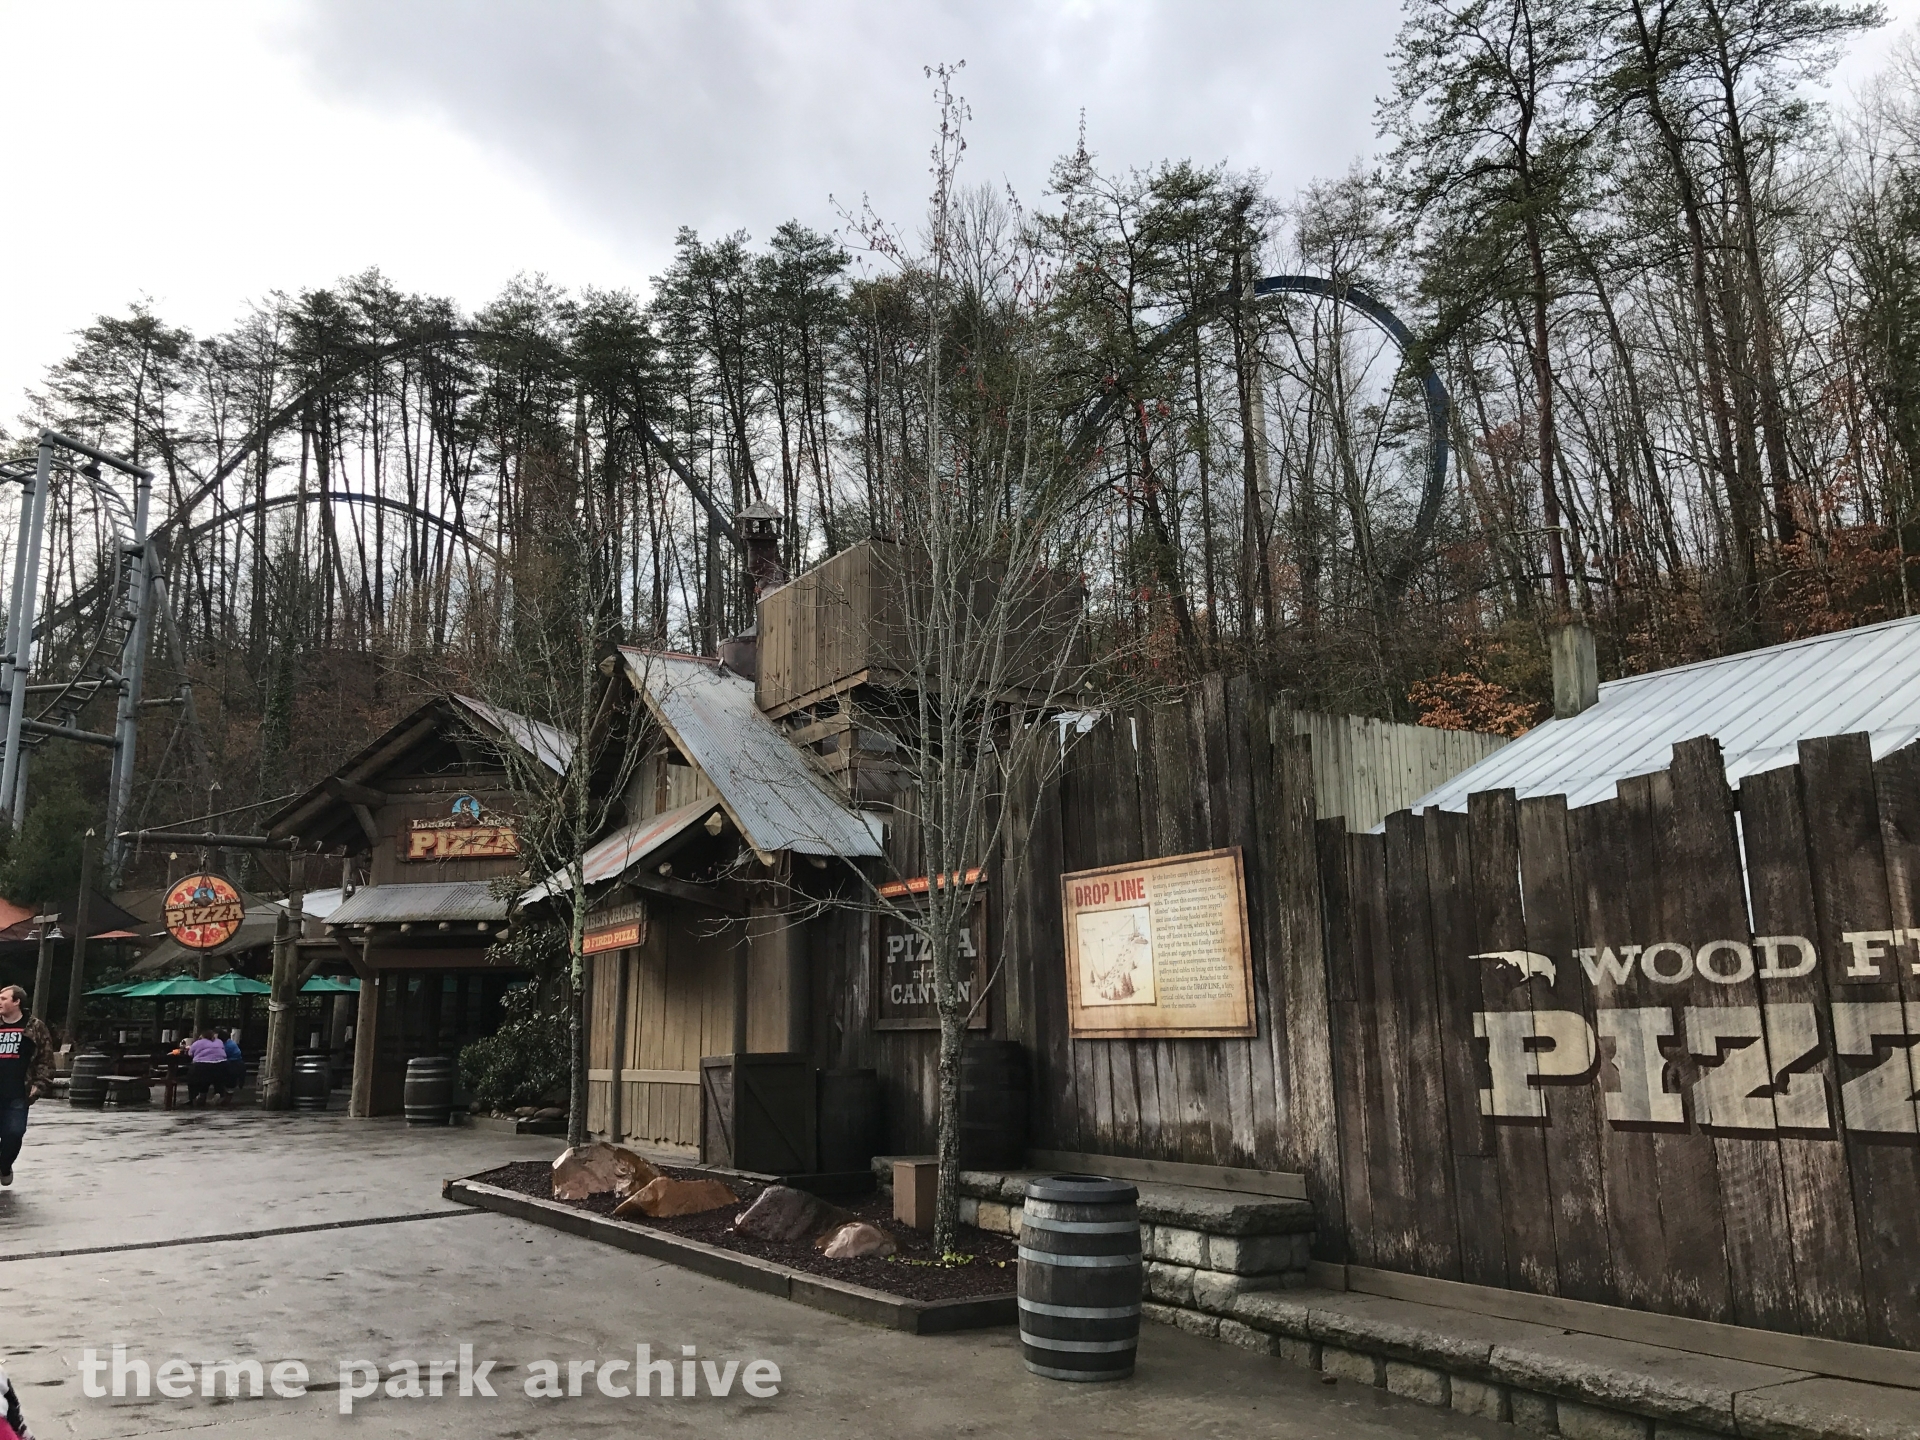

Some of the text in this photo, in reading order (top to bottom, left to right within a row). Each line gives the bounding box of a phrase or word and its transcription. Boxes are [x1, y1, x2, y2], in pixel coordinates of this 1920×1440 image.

[412, 819, 457, 829] Lumber
[411, 828, 517, 857] PIZZA
[1075, 877, 1146, 908] DROP LINE
[166, 904, 245, 928] PIZZA
[592, 934, 612, 948] FIRED
[614, 928, 638, 942] PIZZA
[887, 928, 977, 963] PIZA
[1572, 935, 1817, 986] WOOD
[890, 981, 970, 1004] CANYN
[1472, 1001, 1920, 1133] PIZZ
